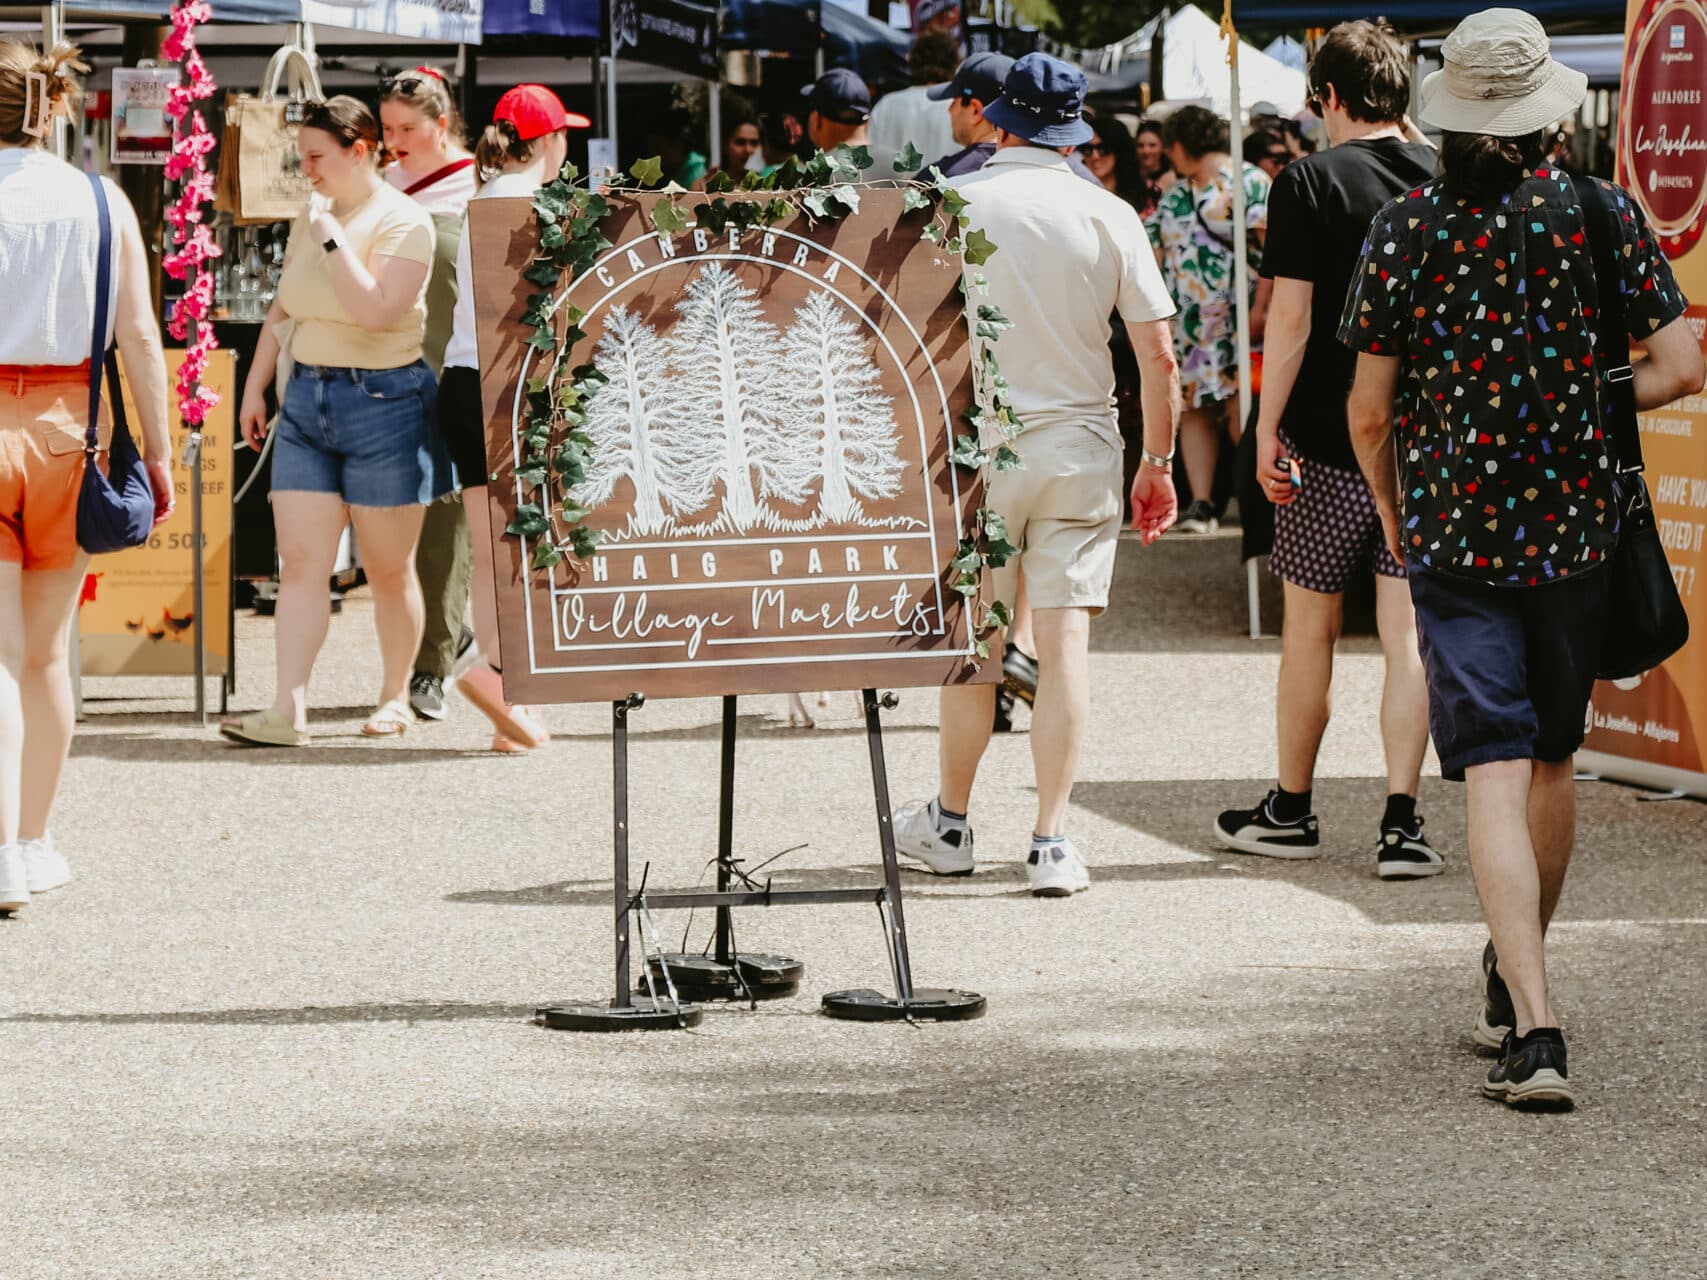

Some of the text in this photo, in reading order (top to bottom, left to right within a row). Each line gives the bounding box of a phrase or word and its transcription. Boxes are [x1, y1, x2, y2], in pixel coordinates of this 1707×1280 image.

[1651, 89, 1701, 105] ALFAJORES
[1635, 124, 1654, 153] La
[596, 228, 841, 288] CANBERRA
[1656, 474, 1689, 507] HAVE
[1659, 519, 1705, 553] TRIED IT
[592, 545, 900, 583] HAIG PARK
[562, 581, 938, 660] Village Markets
